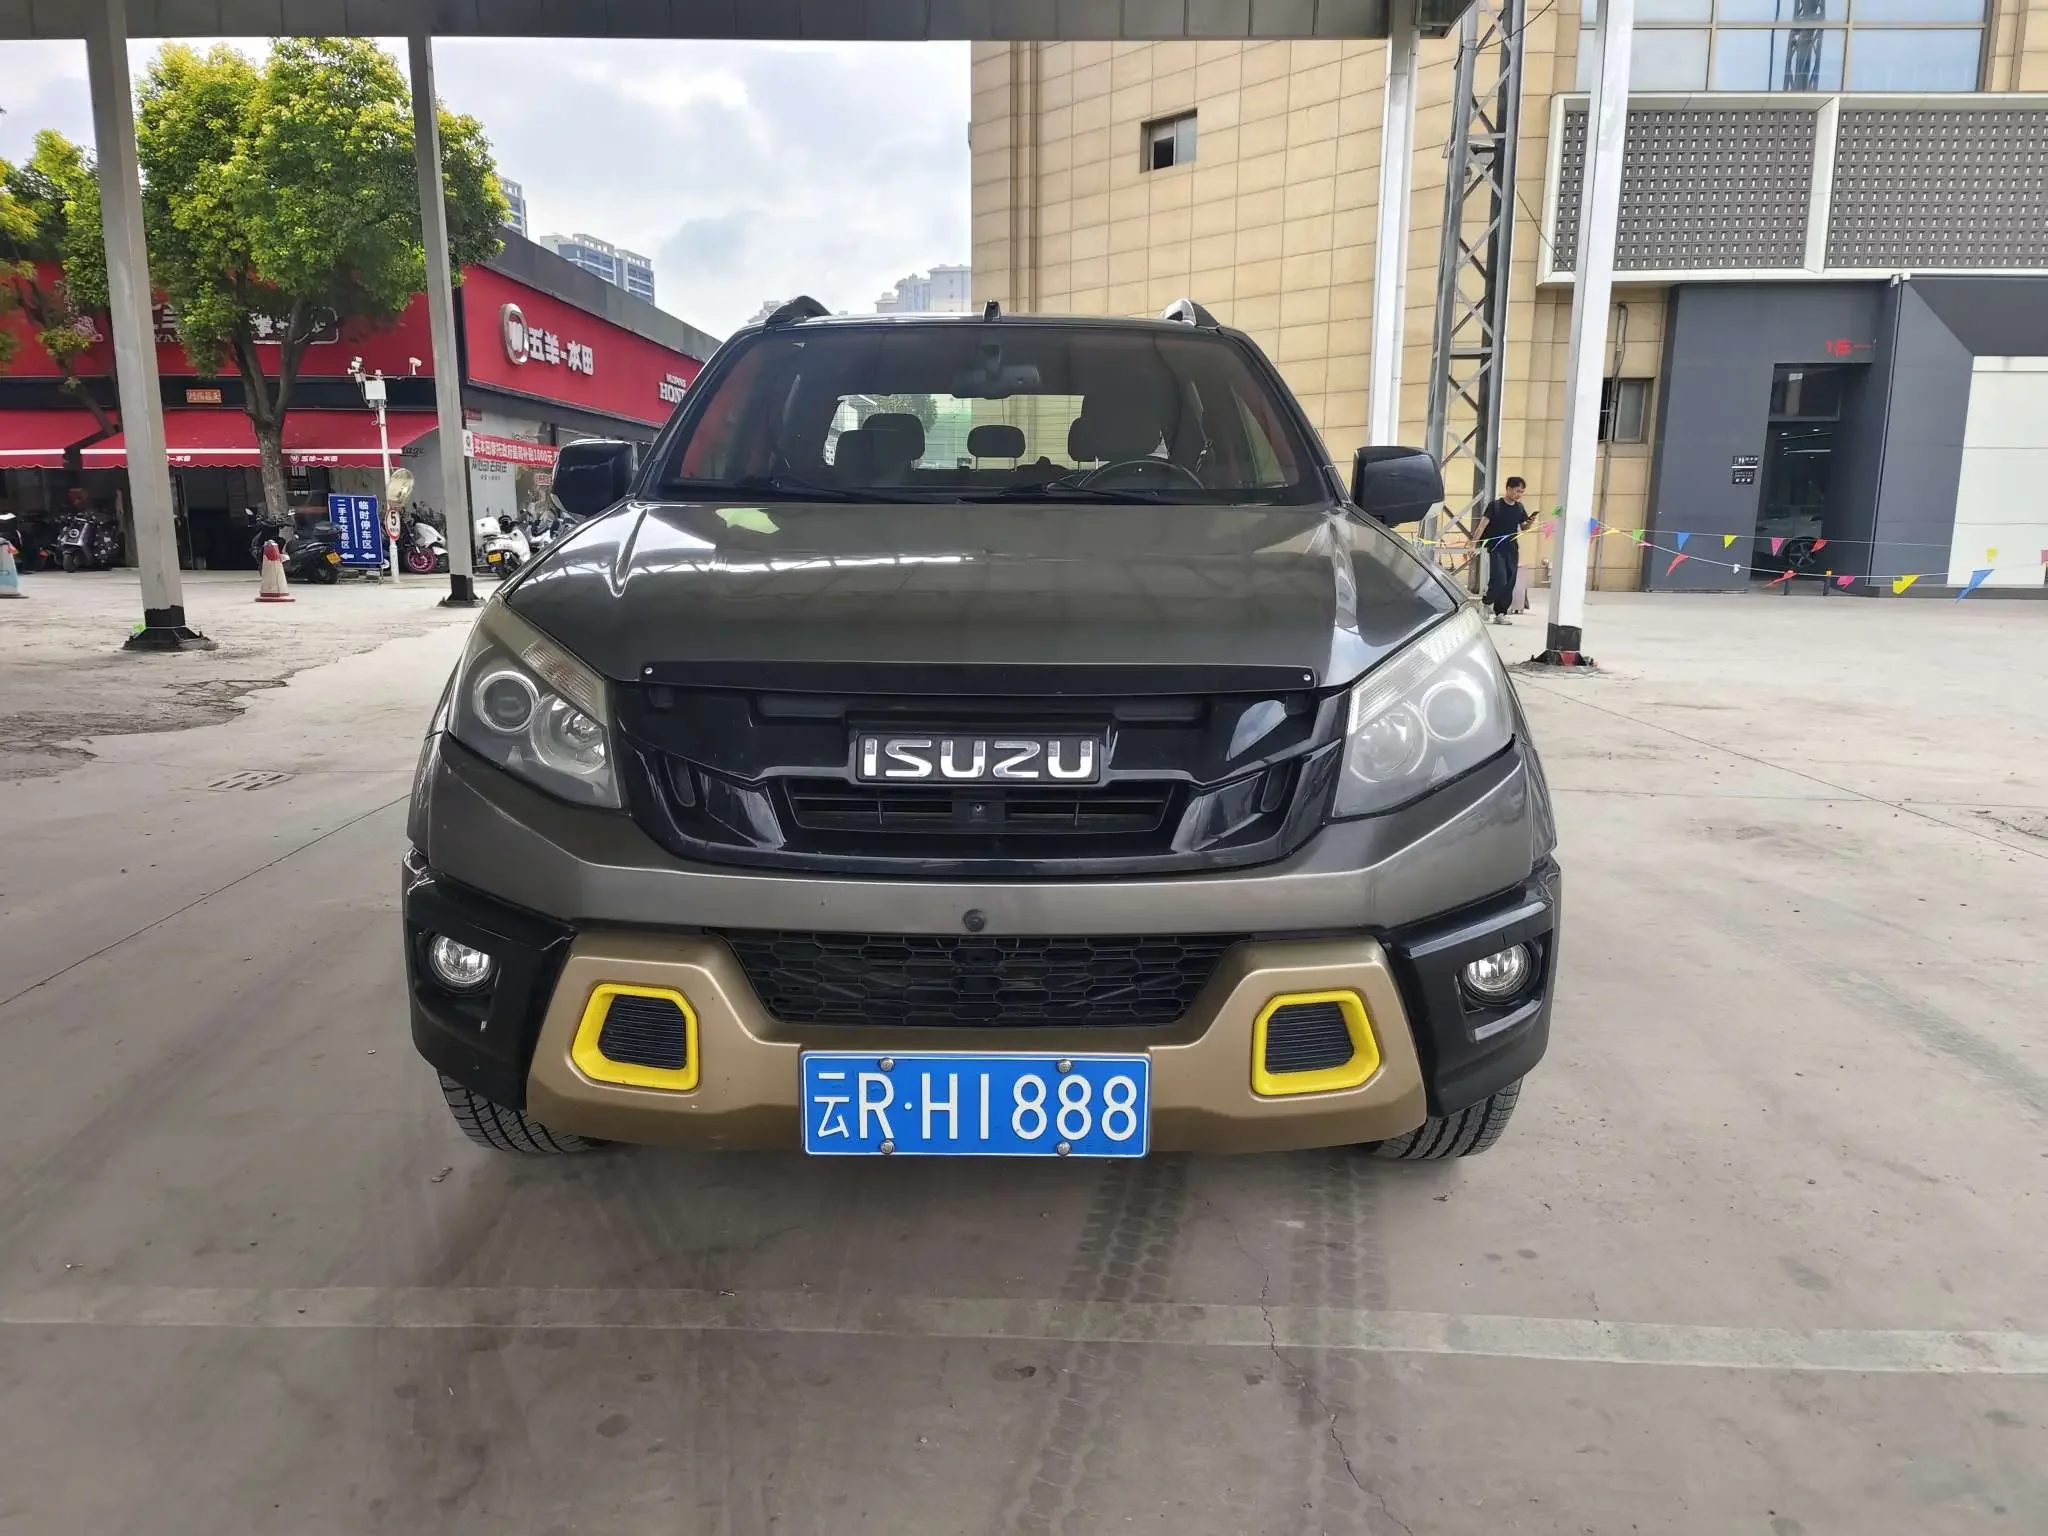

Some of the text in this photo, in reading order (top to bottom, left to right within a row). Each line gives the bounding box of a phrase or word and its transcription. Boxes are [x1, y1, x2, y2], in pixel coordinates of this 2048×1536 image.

[359, 500, 373, 549] 临时停车区
[390, 511, 397, 527] 5
[863, 737, 1094, 778] ISUZU
